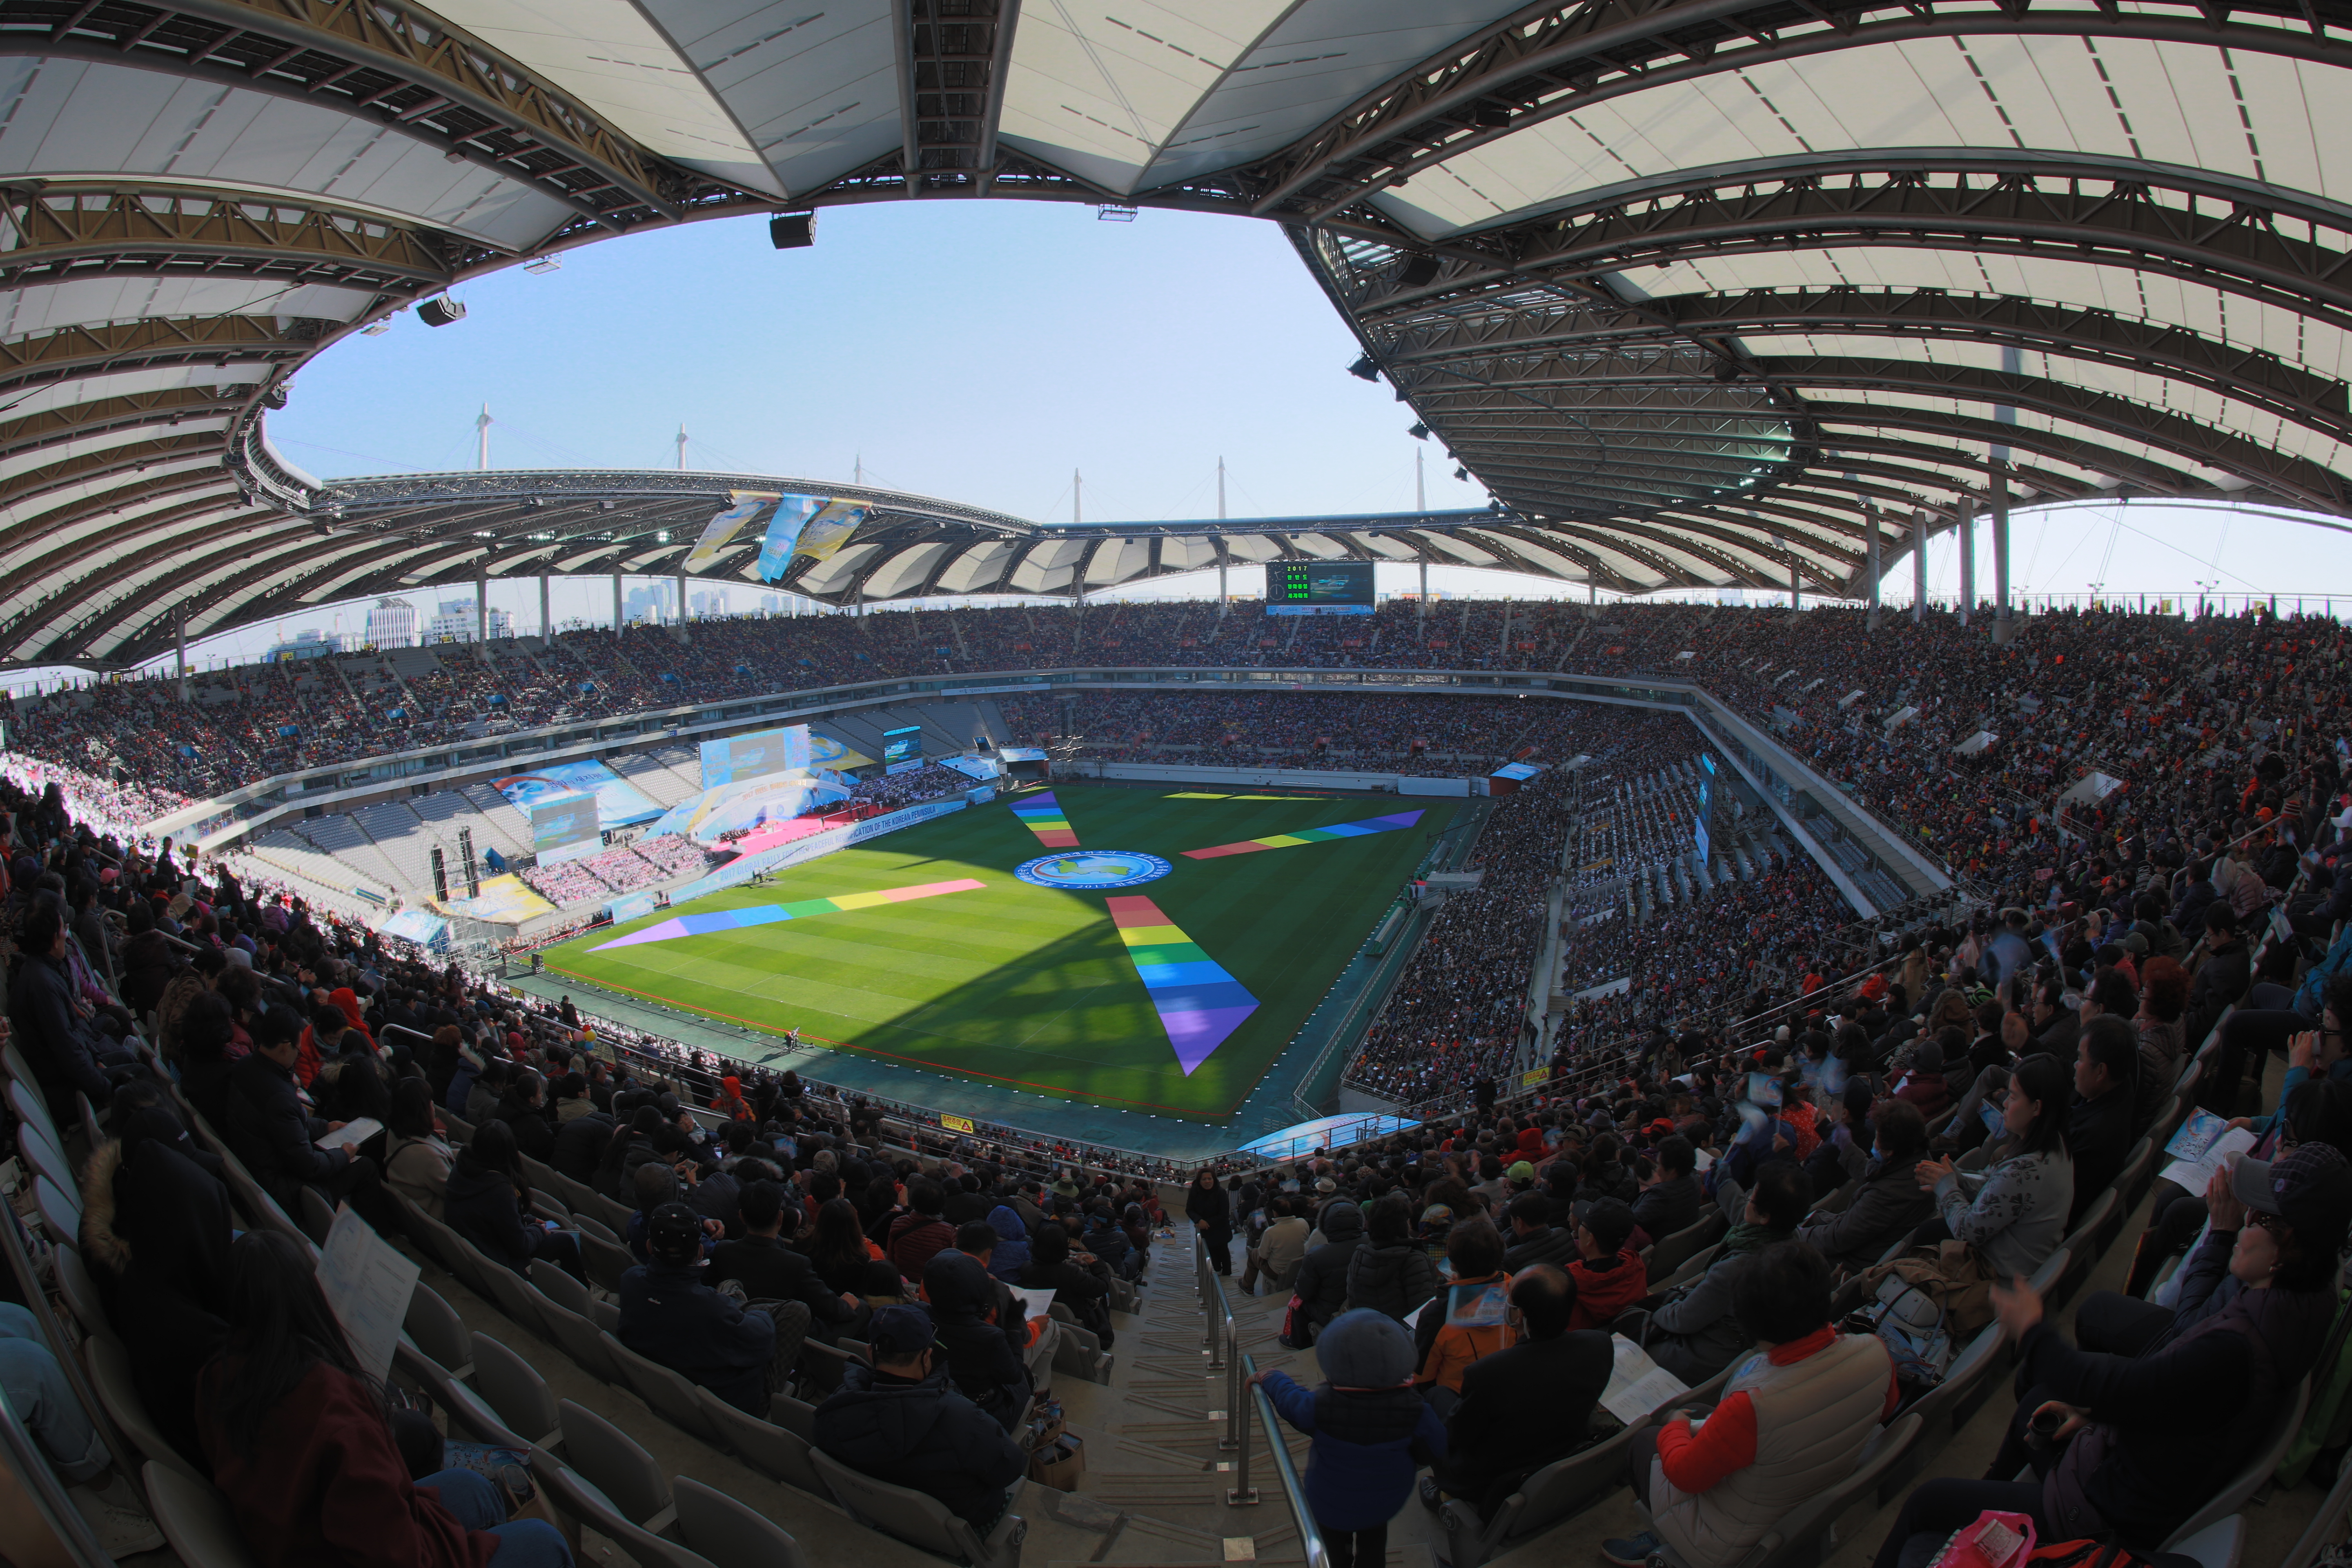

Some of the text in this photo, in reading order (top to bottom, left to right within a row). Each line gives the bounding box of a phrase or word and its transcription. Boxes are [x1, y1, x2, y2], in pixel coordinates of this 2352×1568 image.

[546, 773, 604, 788] 평화의 새지평
[721, 805, 936, 881] 2017 GLOBAL RALLY FOR THE PEACEFUL REUNIFICATION OF THE KOREAN PENINSULA
[1114, 878, 1149, 886] 한반도
[1147, 865, 1169, 878] 평화통일
[1524, 1071, 1540, 1080] 추락주의
[942, 1115, 961, 1126] 추락주의
[1655, 1558, 1664, 1568] P
